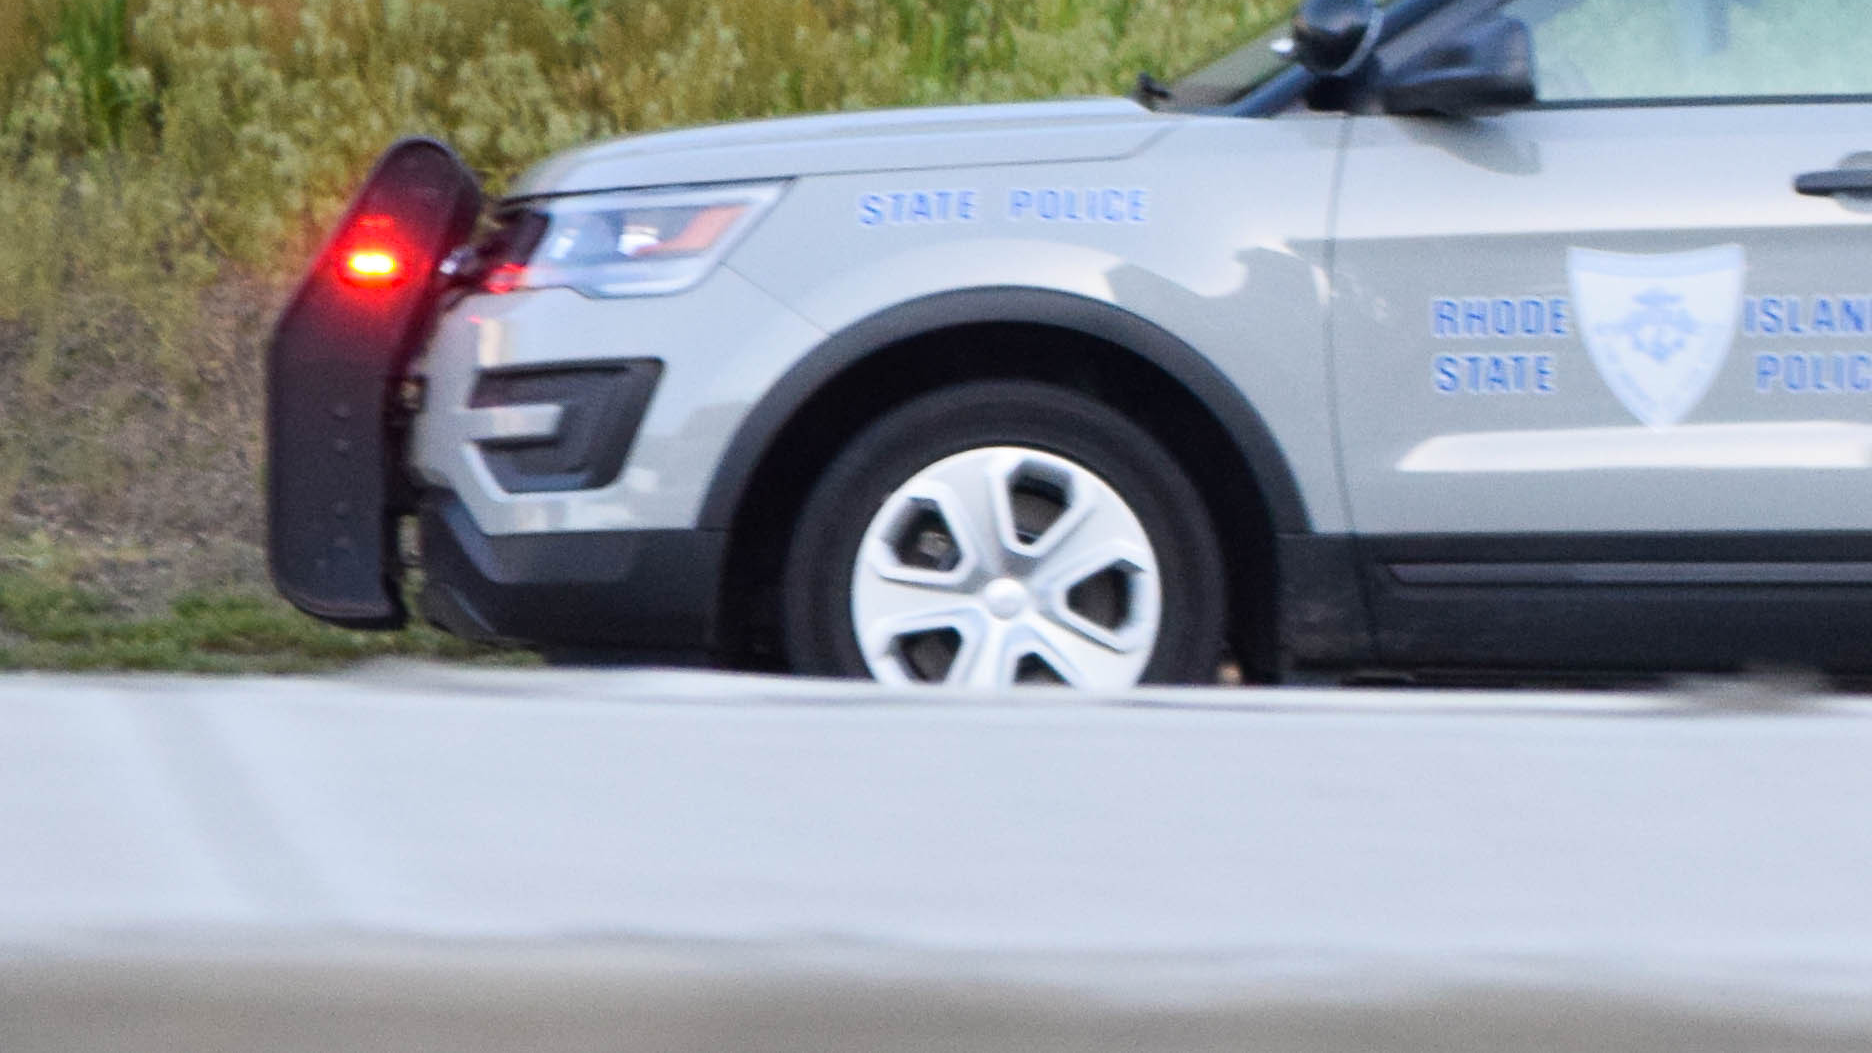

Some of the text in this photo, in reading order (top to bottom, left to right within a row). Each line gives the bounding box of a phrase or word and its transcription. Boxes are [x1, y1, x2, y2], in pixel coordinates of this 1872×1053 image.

[859, 189, 1148, 225] STATE POLICE
[1433, 298, 1570, 337] RHODE
[1434, 354, 1556, 393] STATE
